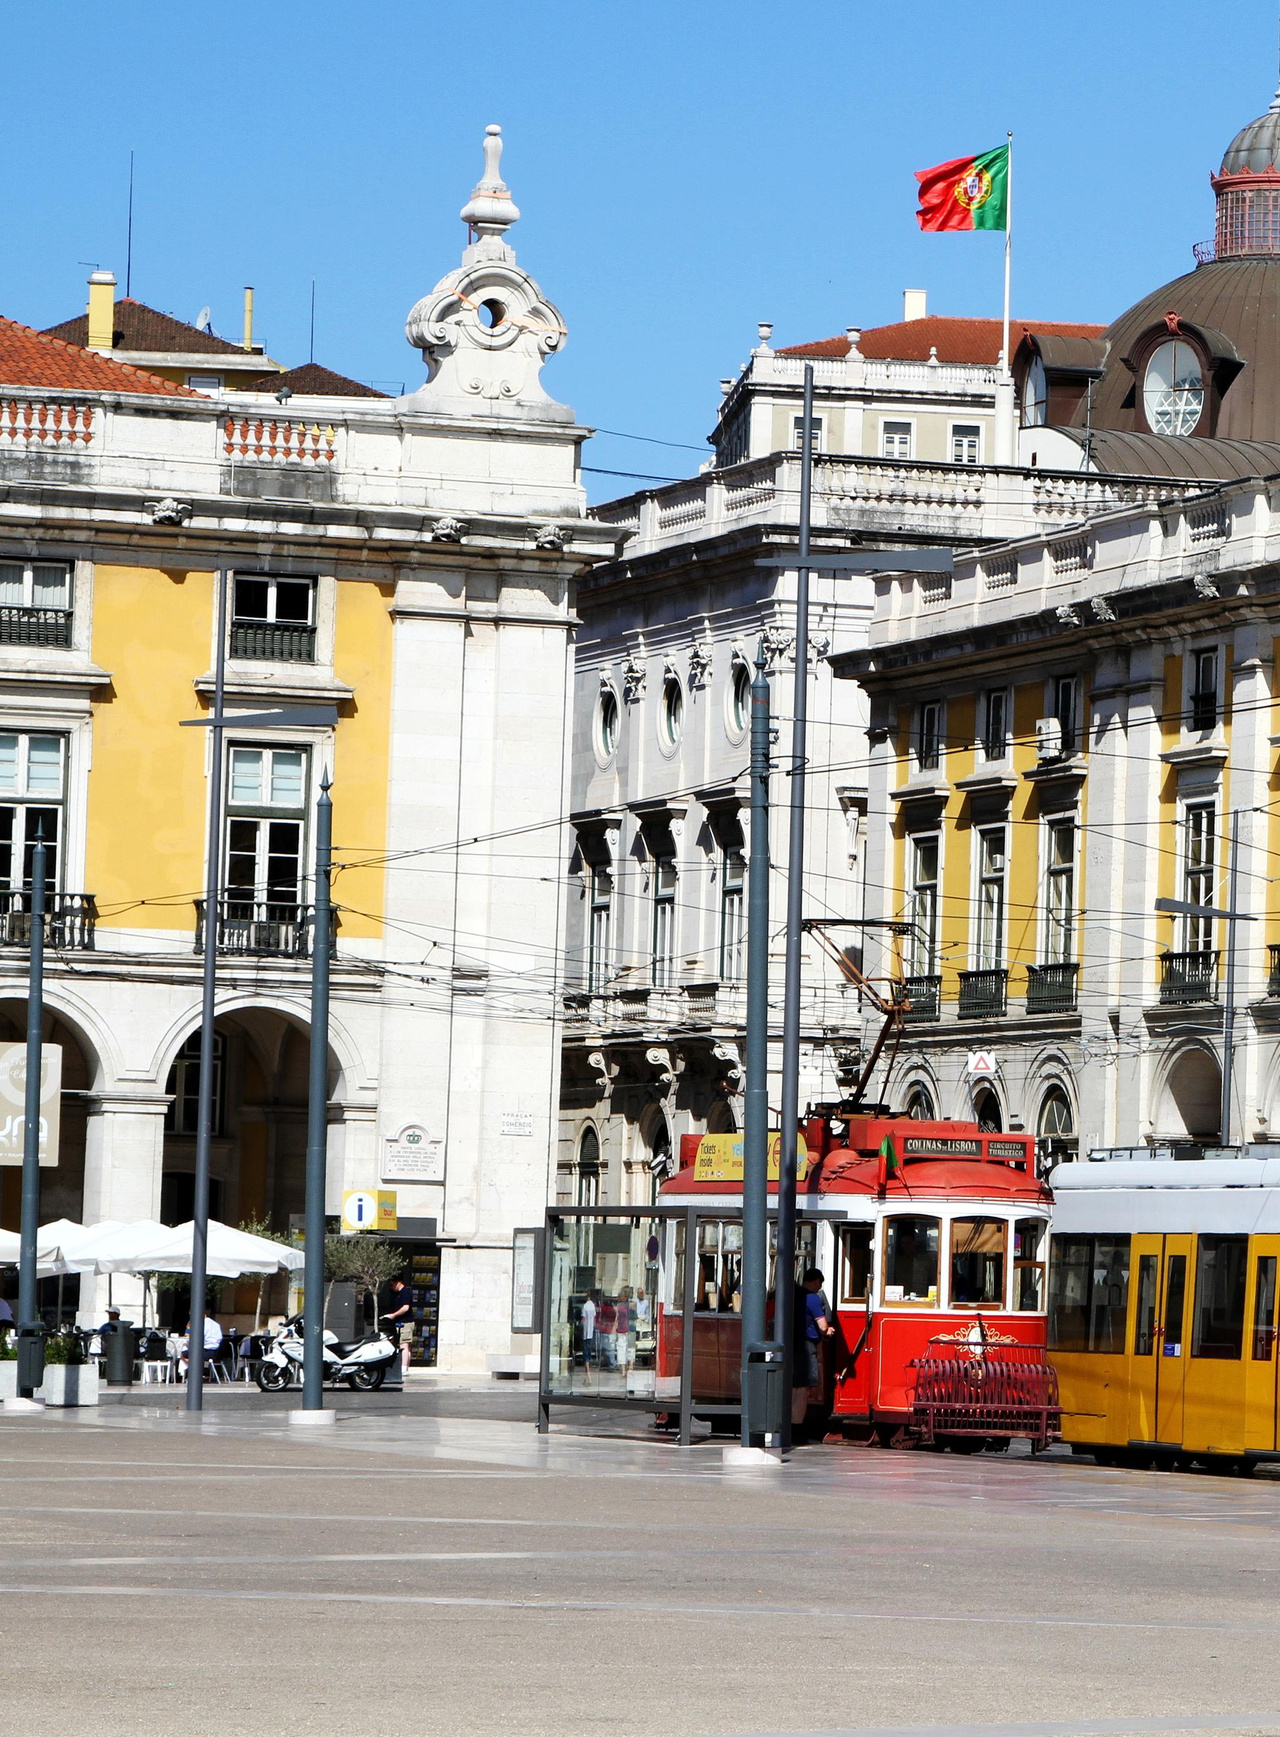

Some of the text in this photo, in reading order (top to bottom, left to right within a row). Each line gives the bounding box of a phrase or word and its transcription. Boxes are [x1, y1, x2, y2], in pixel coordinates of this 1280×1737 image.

[701, 1143, 716, 1154] Tickets
[907, 1139, 942, 1151] COLINAS
[947, 1140, 977, 1153] LISBOA
[989, 1141, 1022, 1149] CIRCUITO
[699, 1156, 713, 1168] inside
